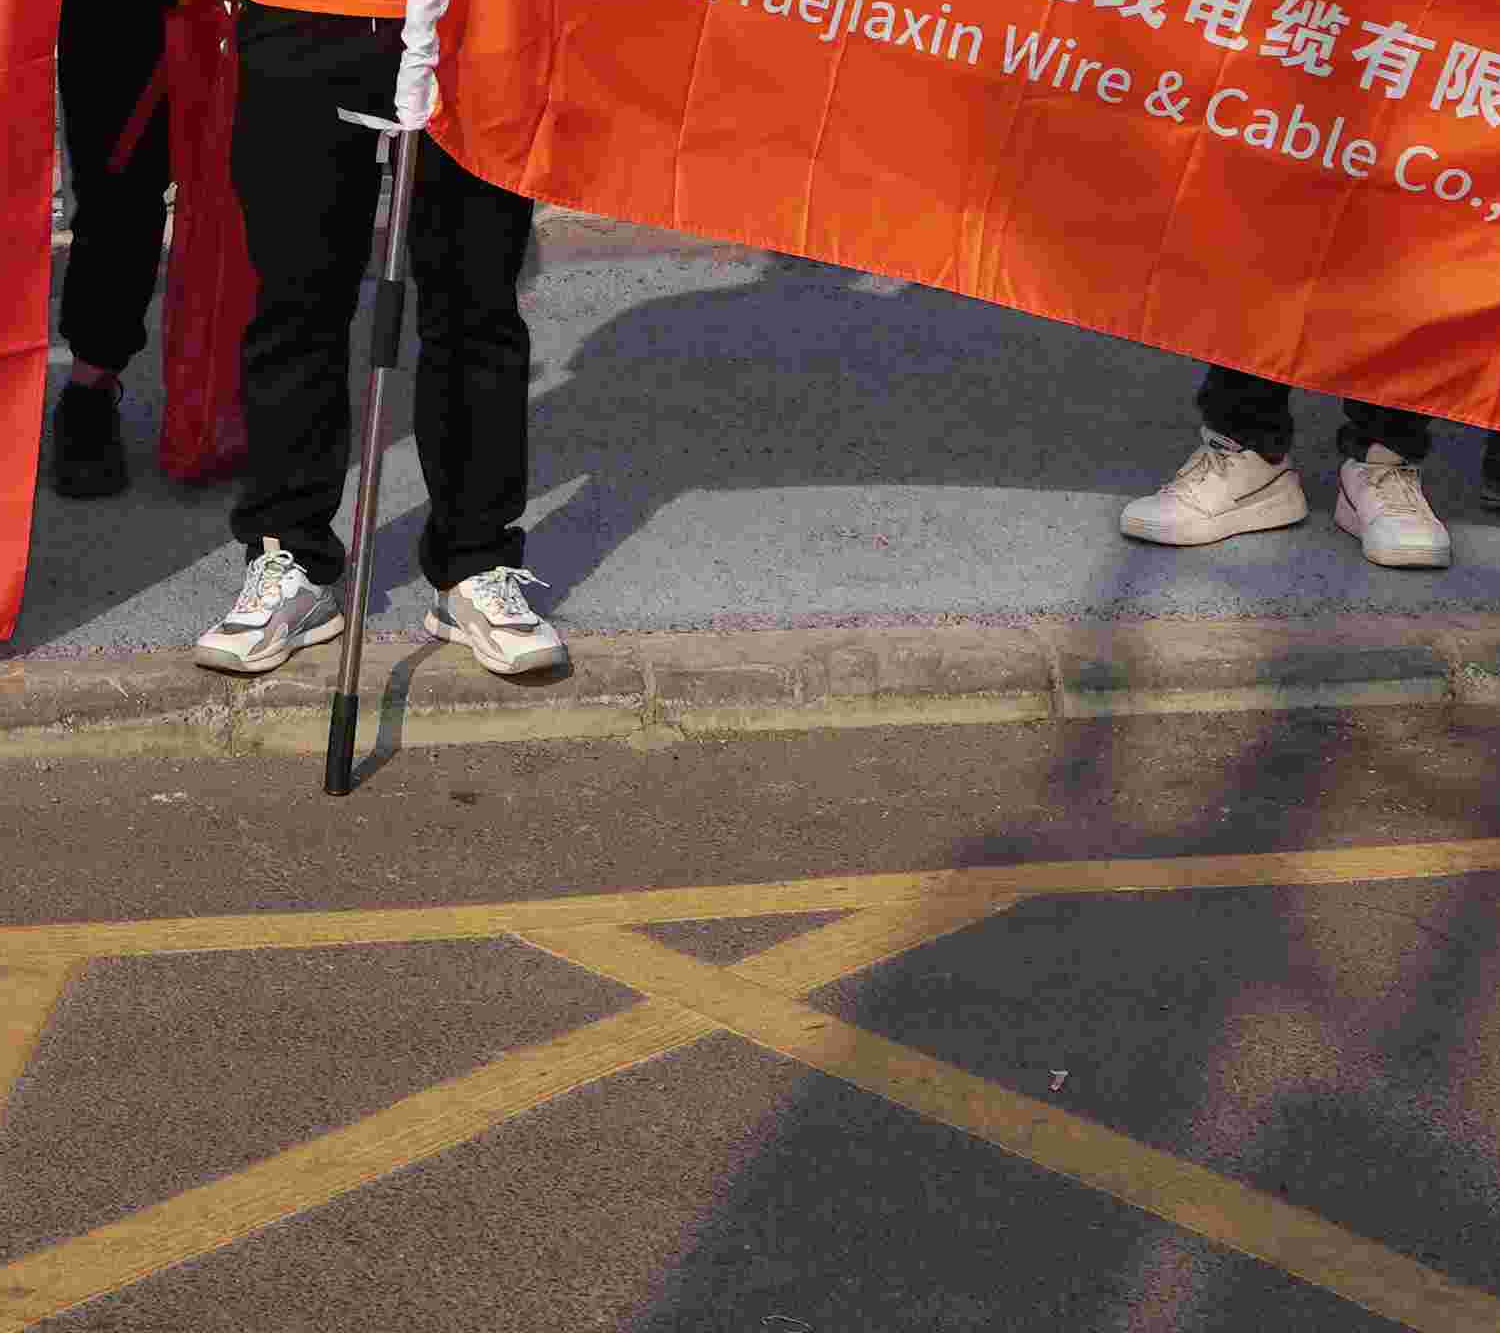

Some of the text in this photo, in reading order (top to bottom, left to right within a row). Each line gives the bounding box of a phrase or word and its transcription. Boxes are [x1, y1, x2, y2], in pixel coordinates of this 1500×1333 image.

[1001, 24, 1132, 104] Wire
[1144, 69, 1187, 125] &
[1205, 87, 1379, 181] Cable
